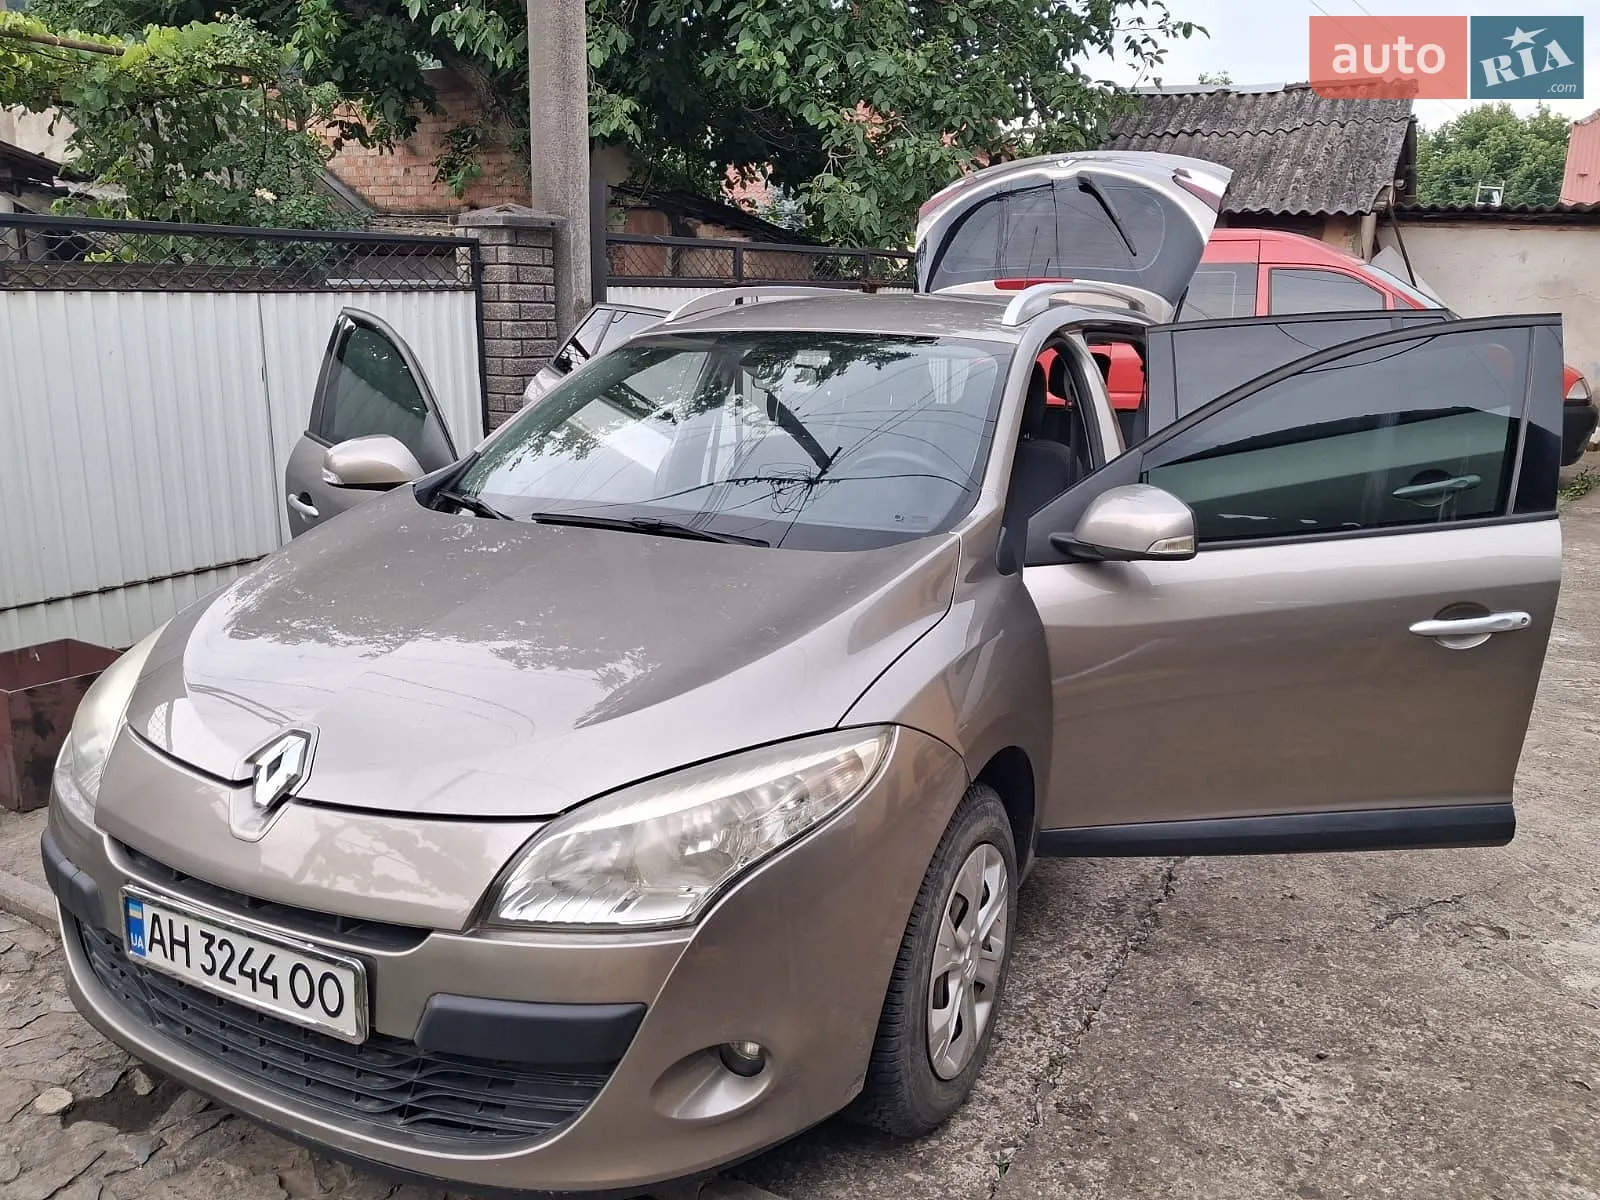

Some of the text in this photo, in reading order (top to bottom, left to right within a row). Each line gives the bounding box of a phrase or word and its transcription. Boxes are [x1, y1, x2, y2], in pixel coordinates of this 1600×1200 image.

[131, 933, 144, 949] UA
[148, 912, 191, 968] AH
[199, 931, 279, 999] 3244
